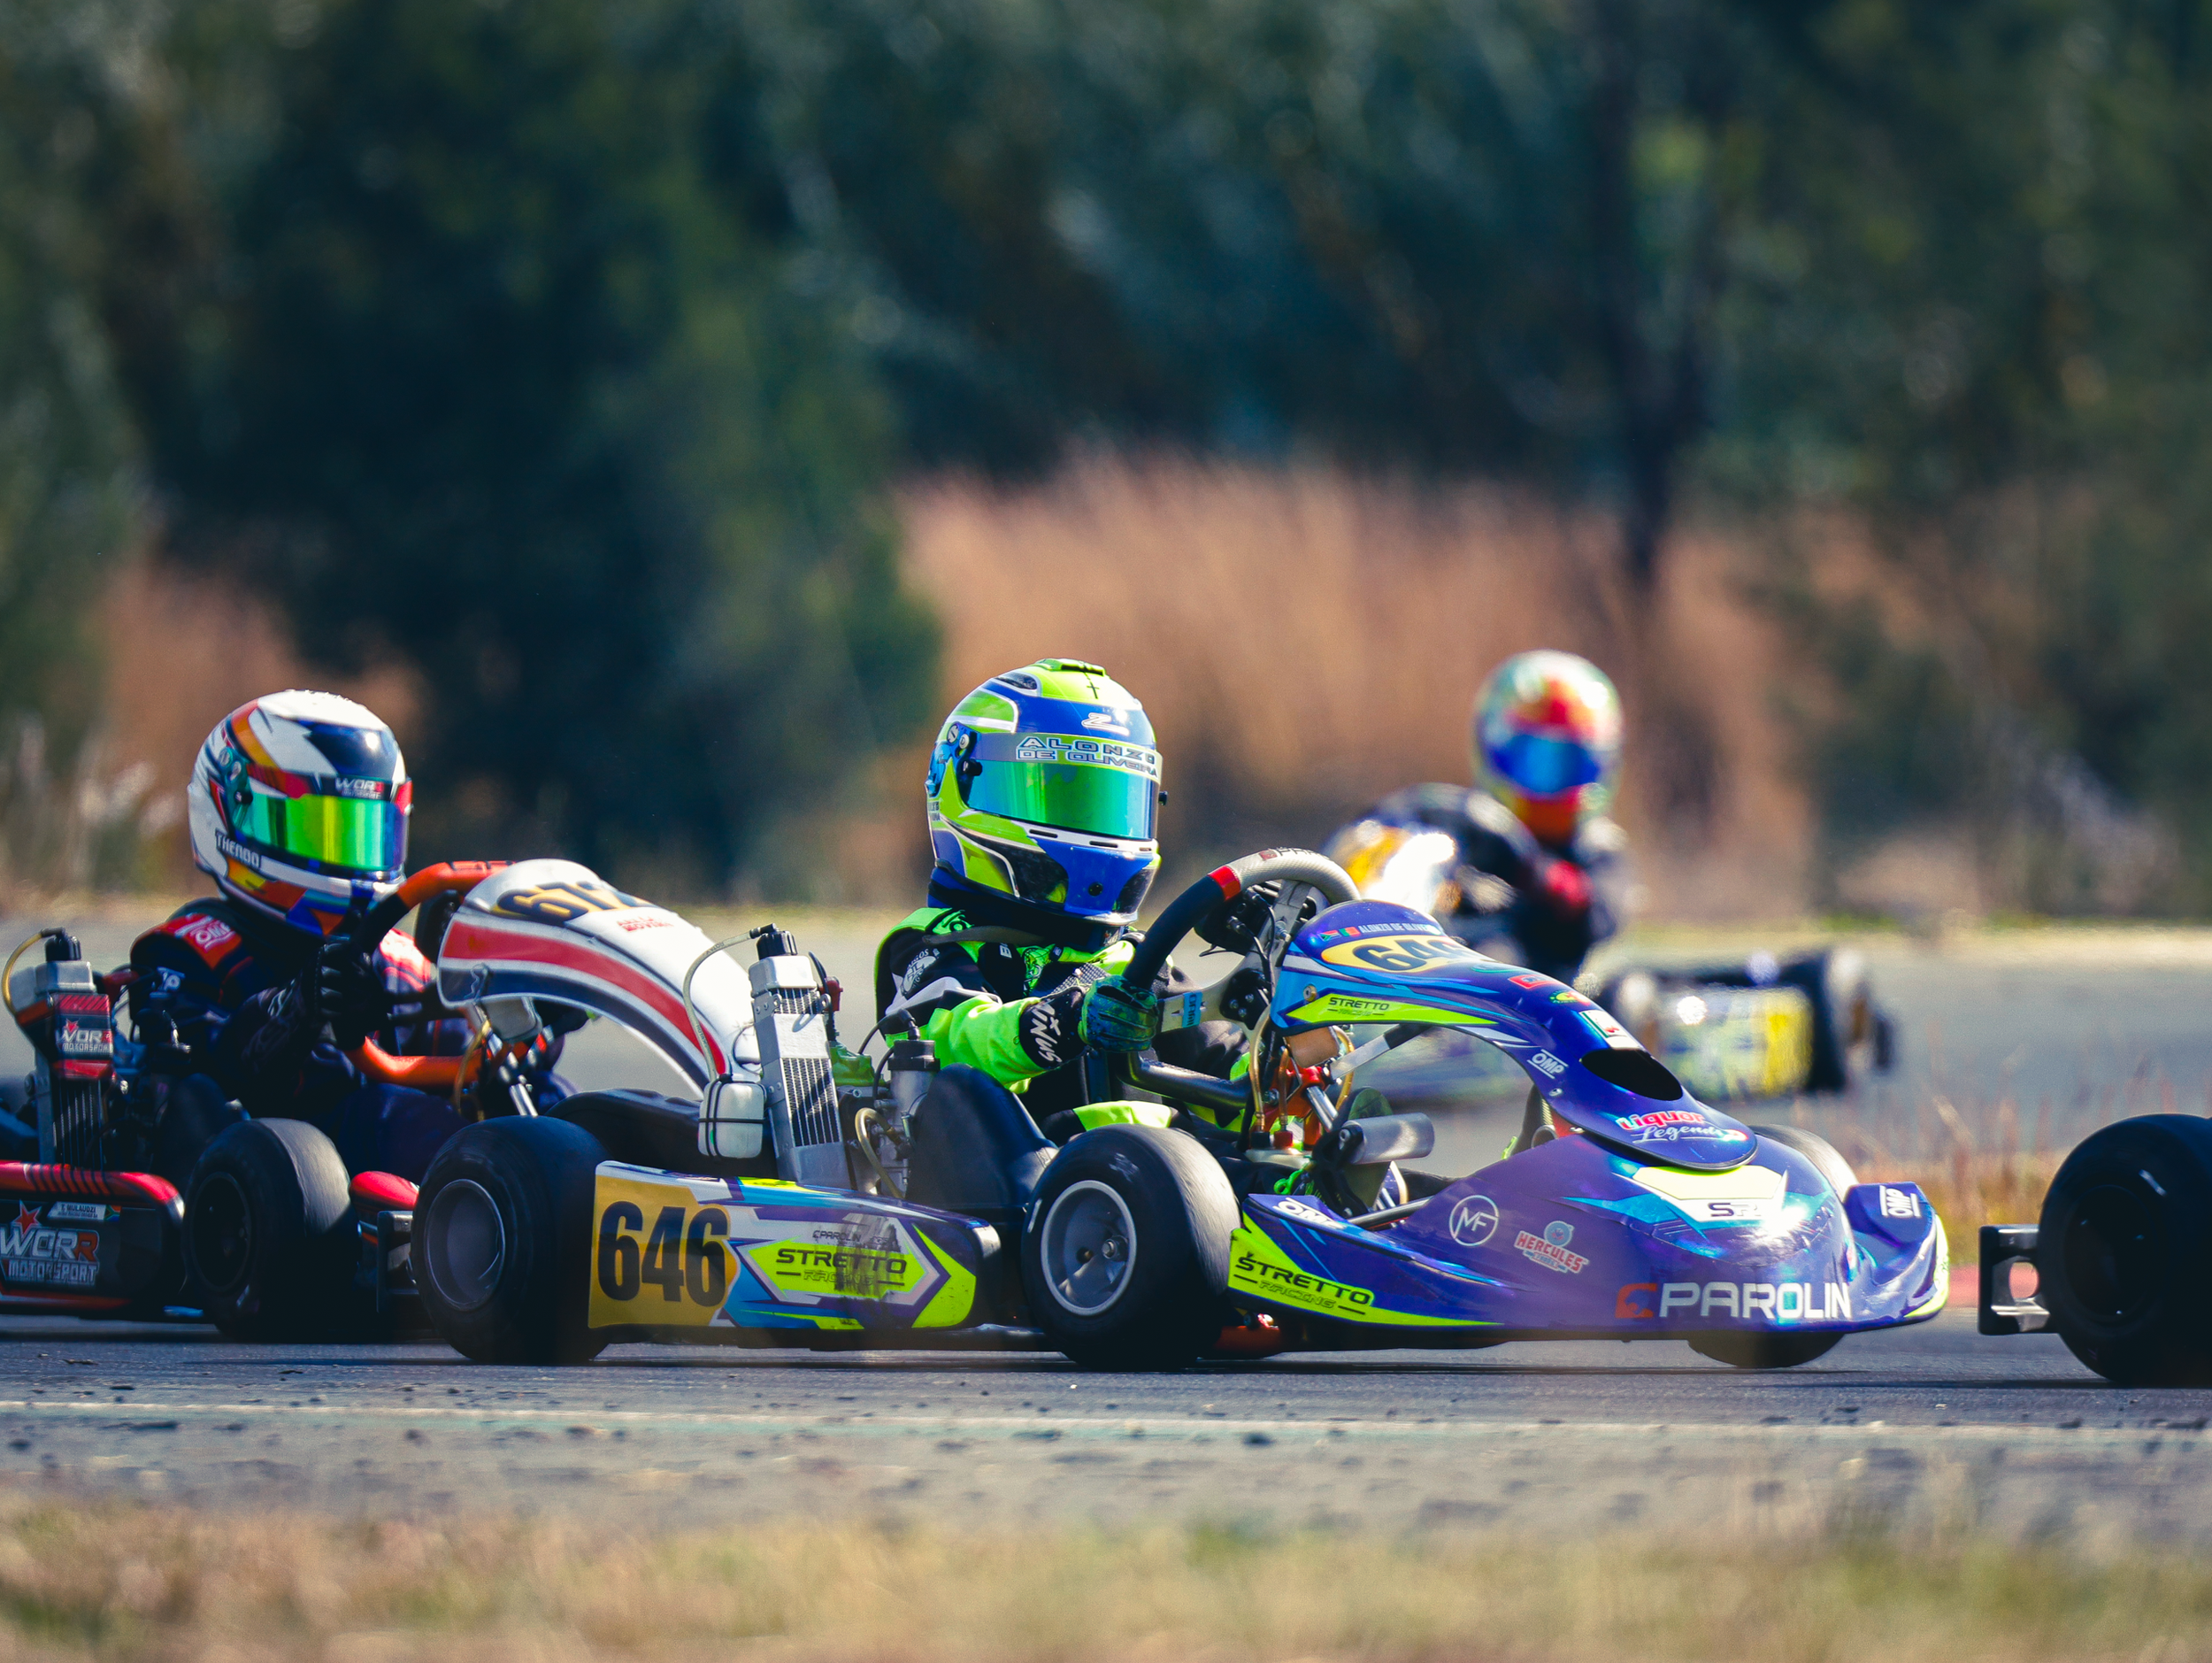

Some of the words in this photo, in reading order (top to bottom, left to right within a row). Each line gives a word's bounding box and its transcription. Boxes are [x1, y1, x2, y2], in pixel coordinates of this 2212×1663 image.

[1018, 736, 1156, 766] ALONZO
[1018, 749, 1056, 760] DE
[1066, 751, 1158, 778] OLIVEIRA
[1352, 938, 1464, 972] 646
[1328, 997, 1390, 1011] STRETTO
[1531, 1051, 1565, 1074] OMP
[1616, 1109, 1706, 1131] Liquor
[1885, 1187, 1914, 1218] OMP
[596, 1199, 732, 1308] 646
[776, 1248, 907, 1274] STRETTO
[1517, 1233, 1584, 1272] HERCULES
[8, 1258, 97, 1287] MOTORSPORT
[1235, 1255, 1371, 1305] STRETTO
[1260, 1280, 1337, 1309] RACING
[1659, 1282, 1853, 1320] PAROLIN
